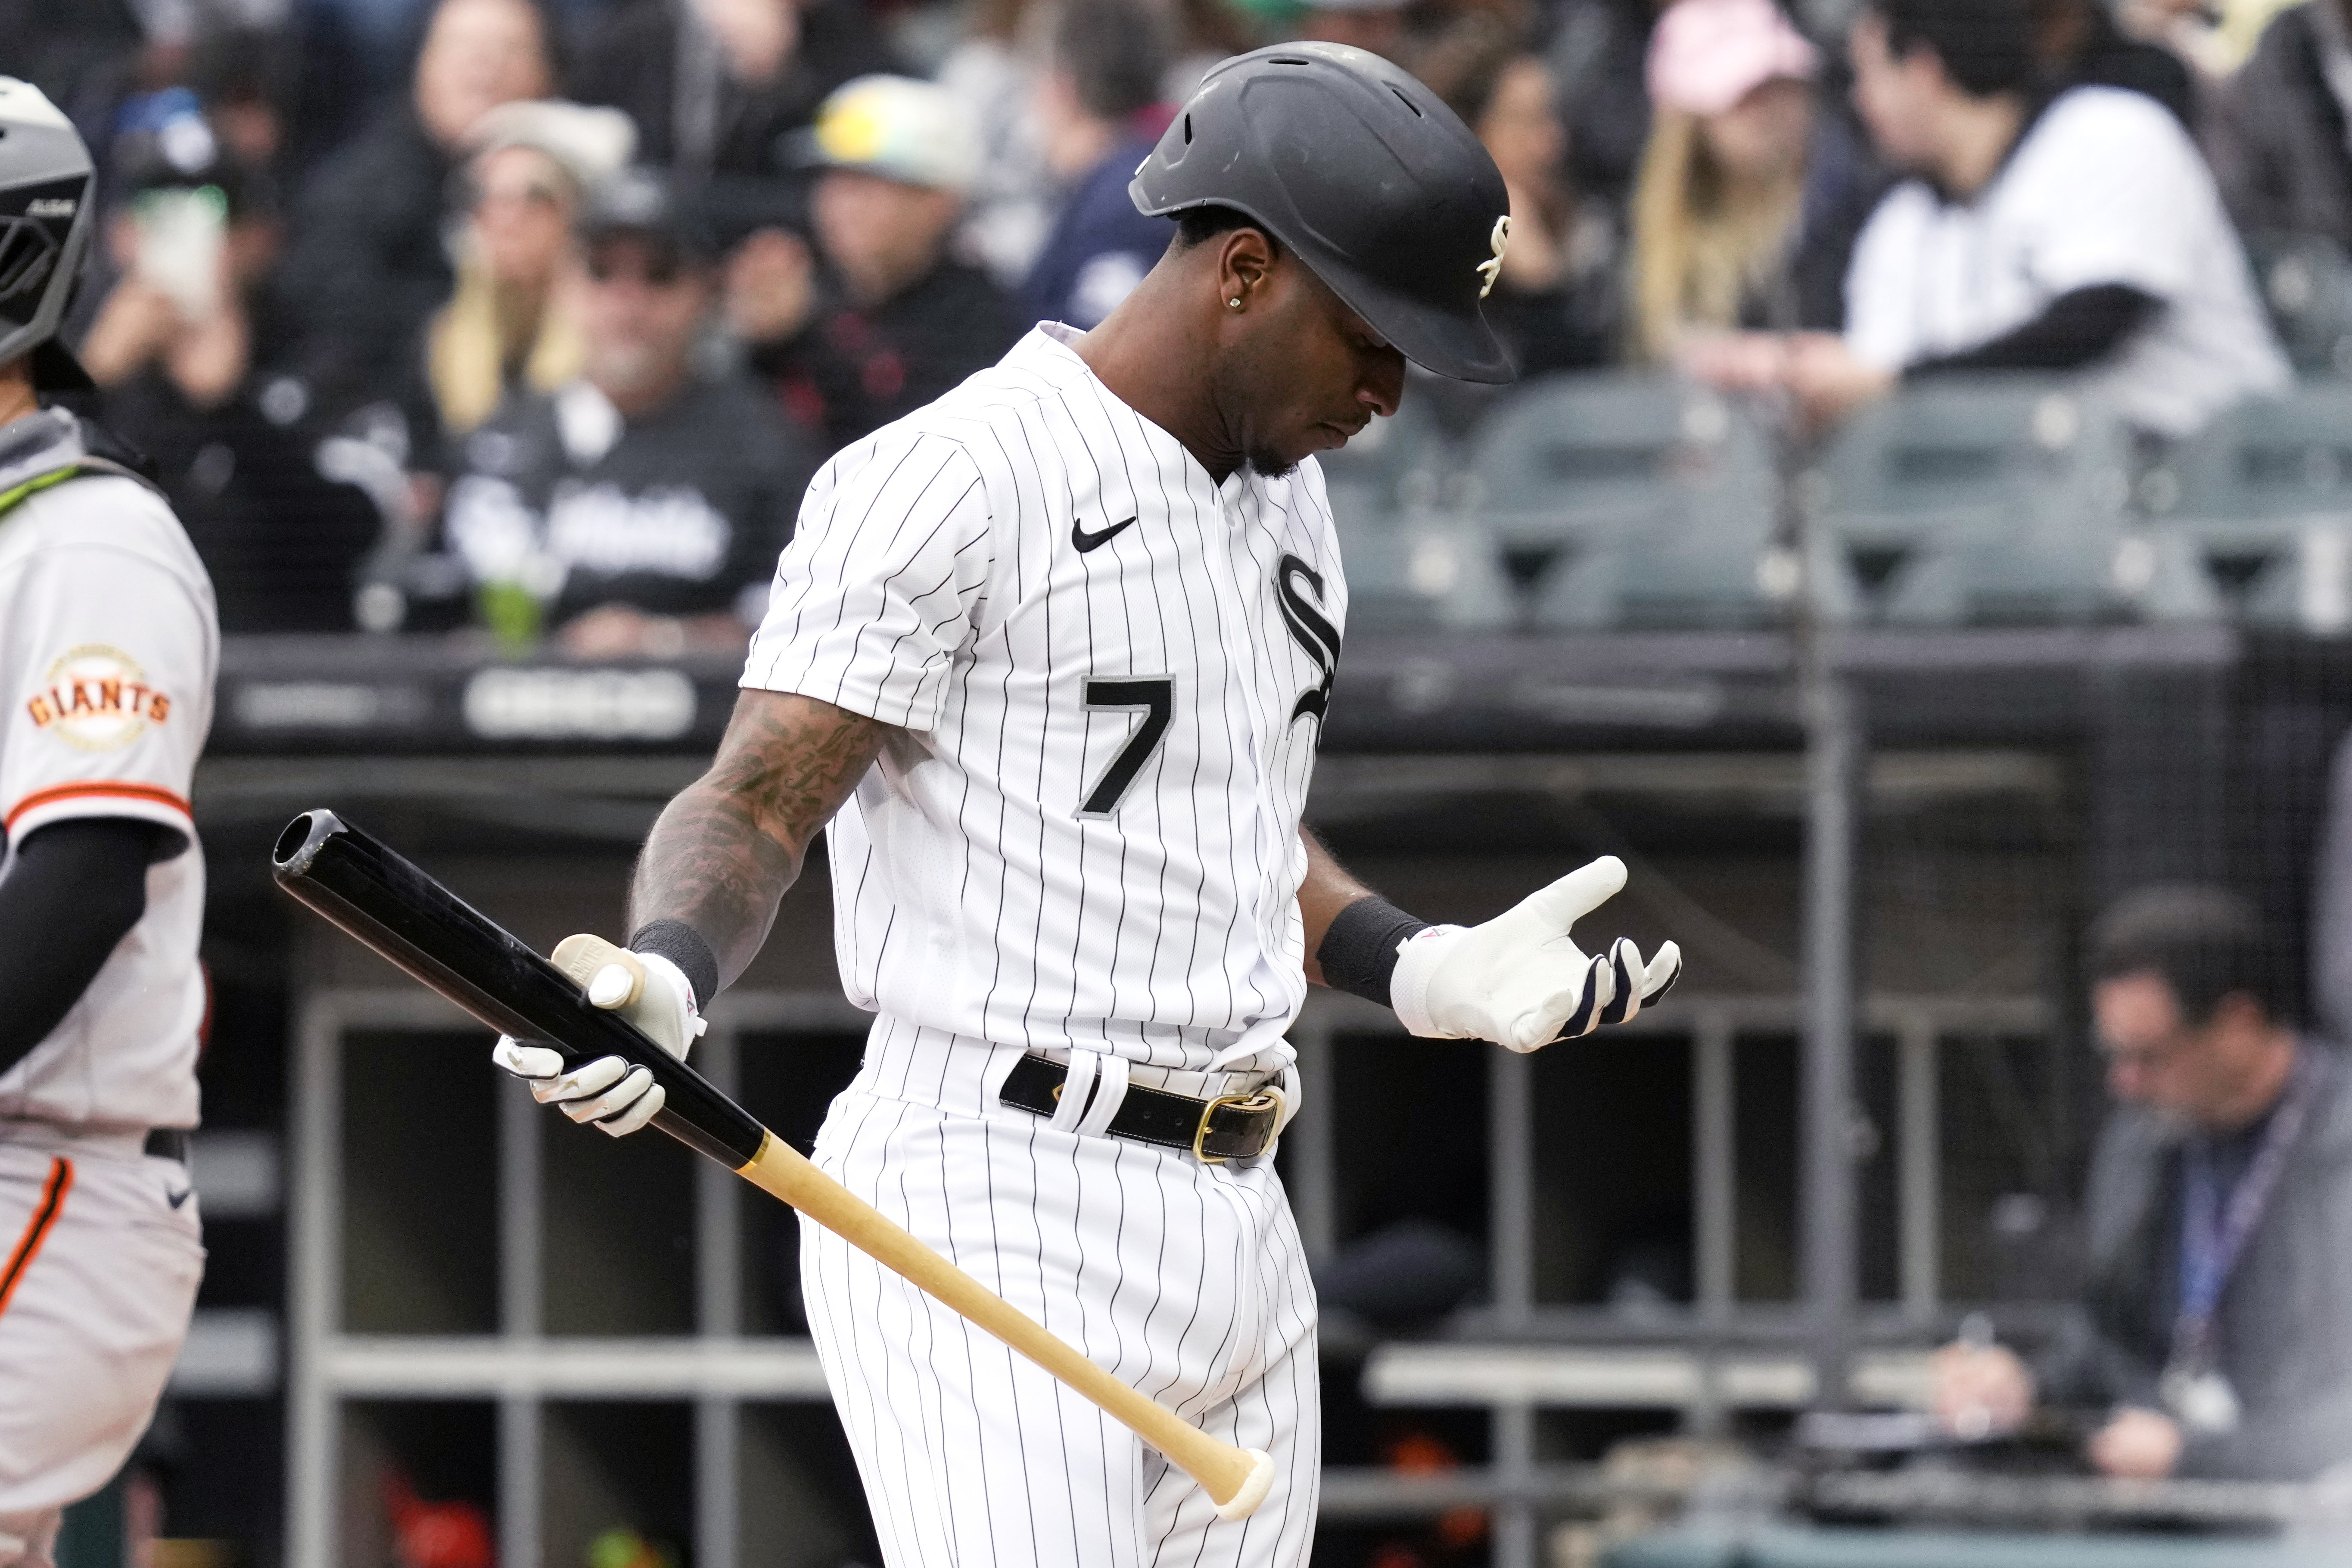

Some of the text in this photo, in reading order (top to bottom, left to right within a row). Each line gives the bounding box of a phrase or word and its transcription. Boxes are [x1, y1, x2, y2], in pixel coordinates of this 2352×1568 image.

[27, 678, 171, 727] GIANTS
[1070, 673, 1176, 821] 7
[567, 939, 607, 984] ROHITTER
